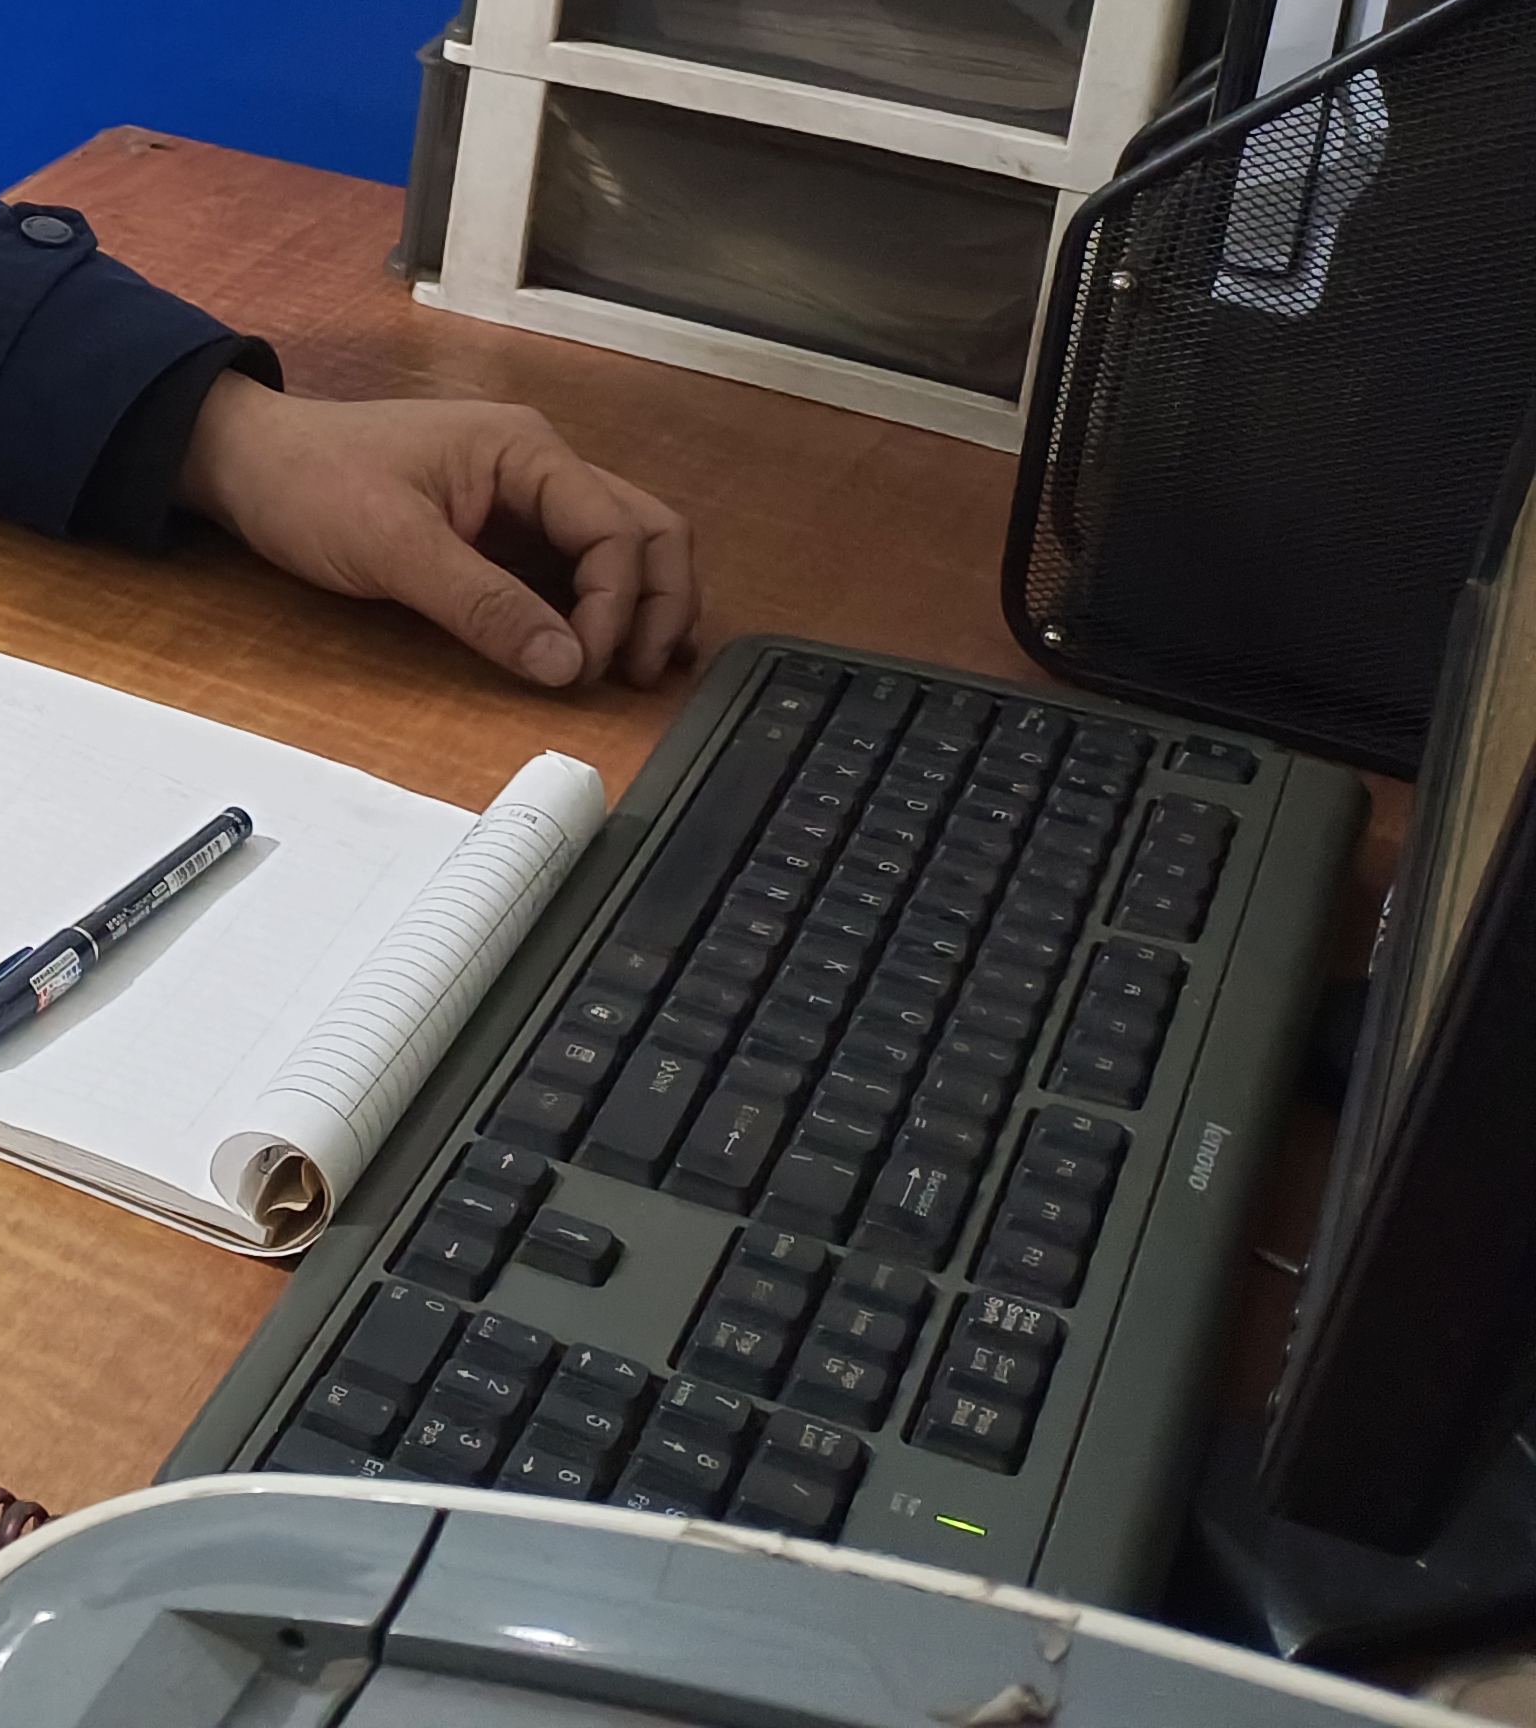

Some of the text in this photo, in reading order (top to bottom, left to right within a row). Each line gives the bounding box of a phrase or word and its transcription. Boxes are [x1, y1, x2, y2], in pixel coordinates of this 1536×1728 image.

[1187, 1122, 1232, 1192] lenovo
[486, 1379, 510, 1396] 2
[585, 1413, 612, 1432] 5
[459, 1433, 482, 1450] 3
